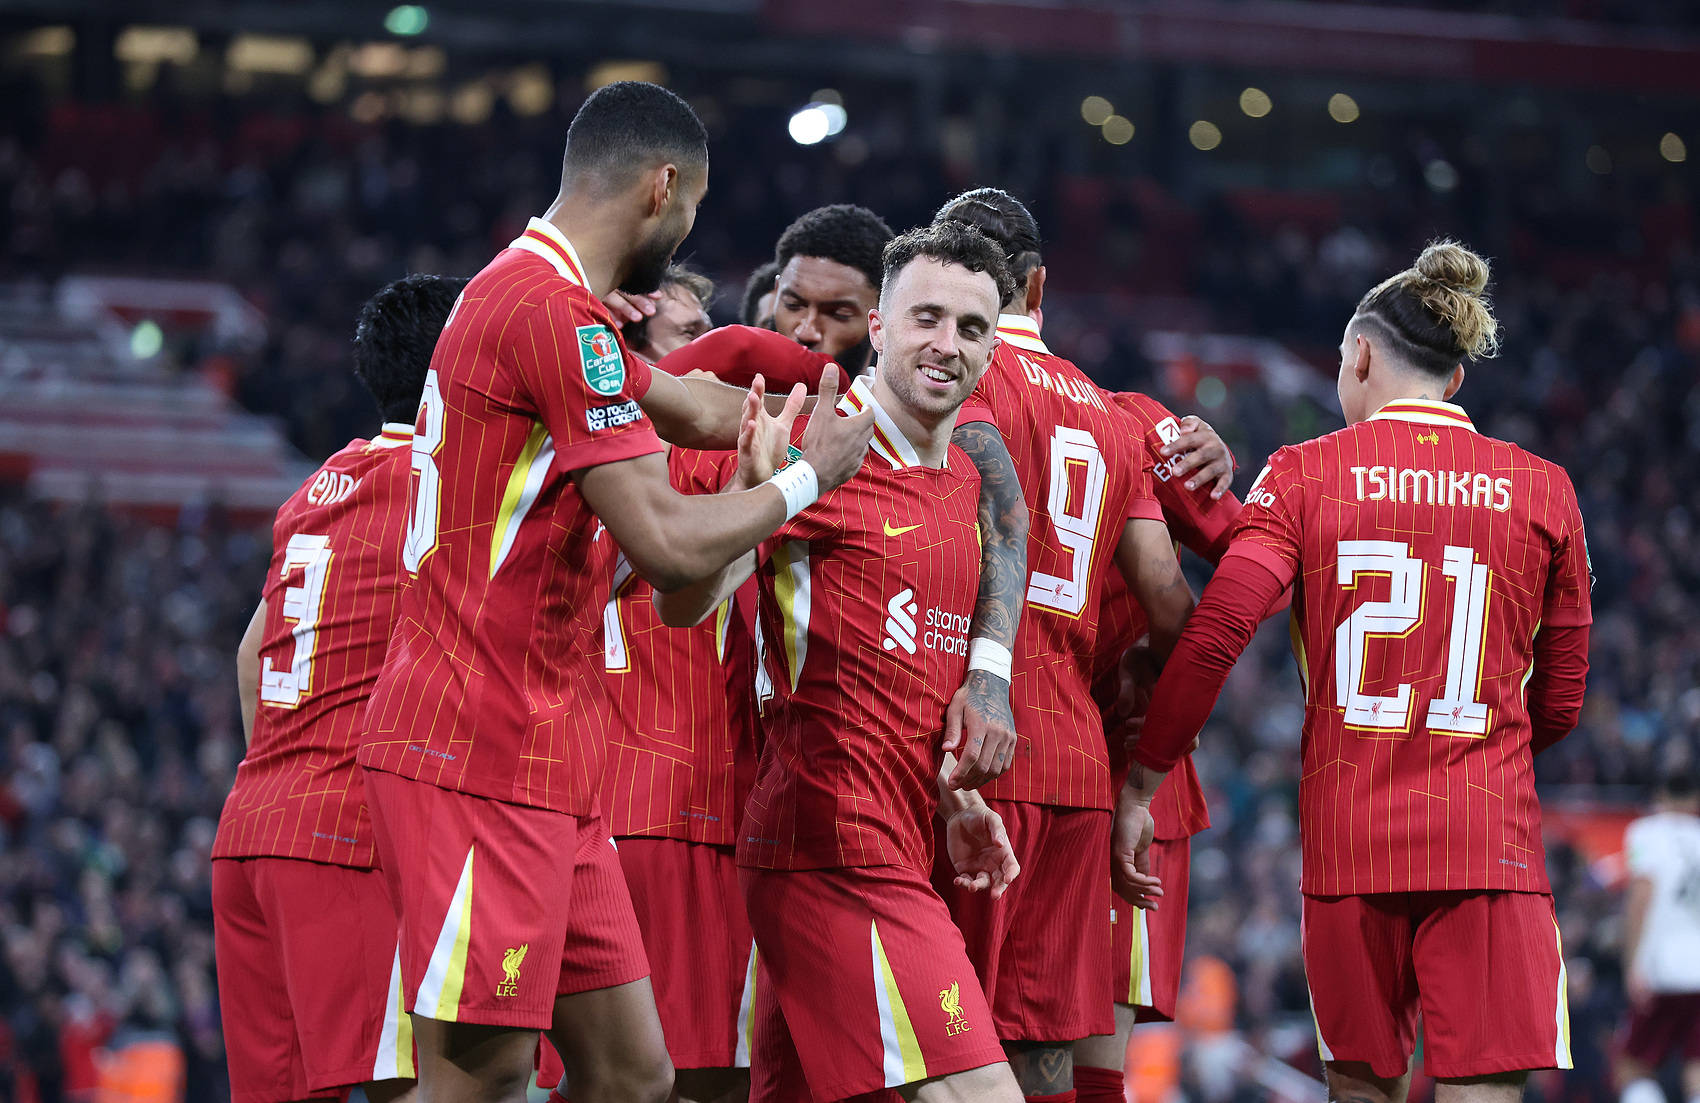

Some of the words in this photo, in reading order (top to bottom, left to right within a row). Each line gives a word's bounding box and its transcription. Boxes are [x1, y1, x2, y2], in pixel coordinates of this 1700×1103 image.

[598, 363, 616, 375] Cup
[585, 407, 606, 420] No
[606, 400, 638, 417] room
[585, 417, 606, 432] for
[1350, 465, 1513, 513] TSIMIKAS
[1026, 424, 1109, 621] 9
[260, 533, 336, 710] 3
[1335, 540, 1494, 740] 21
